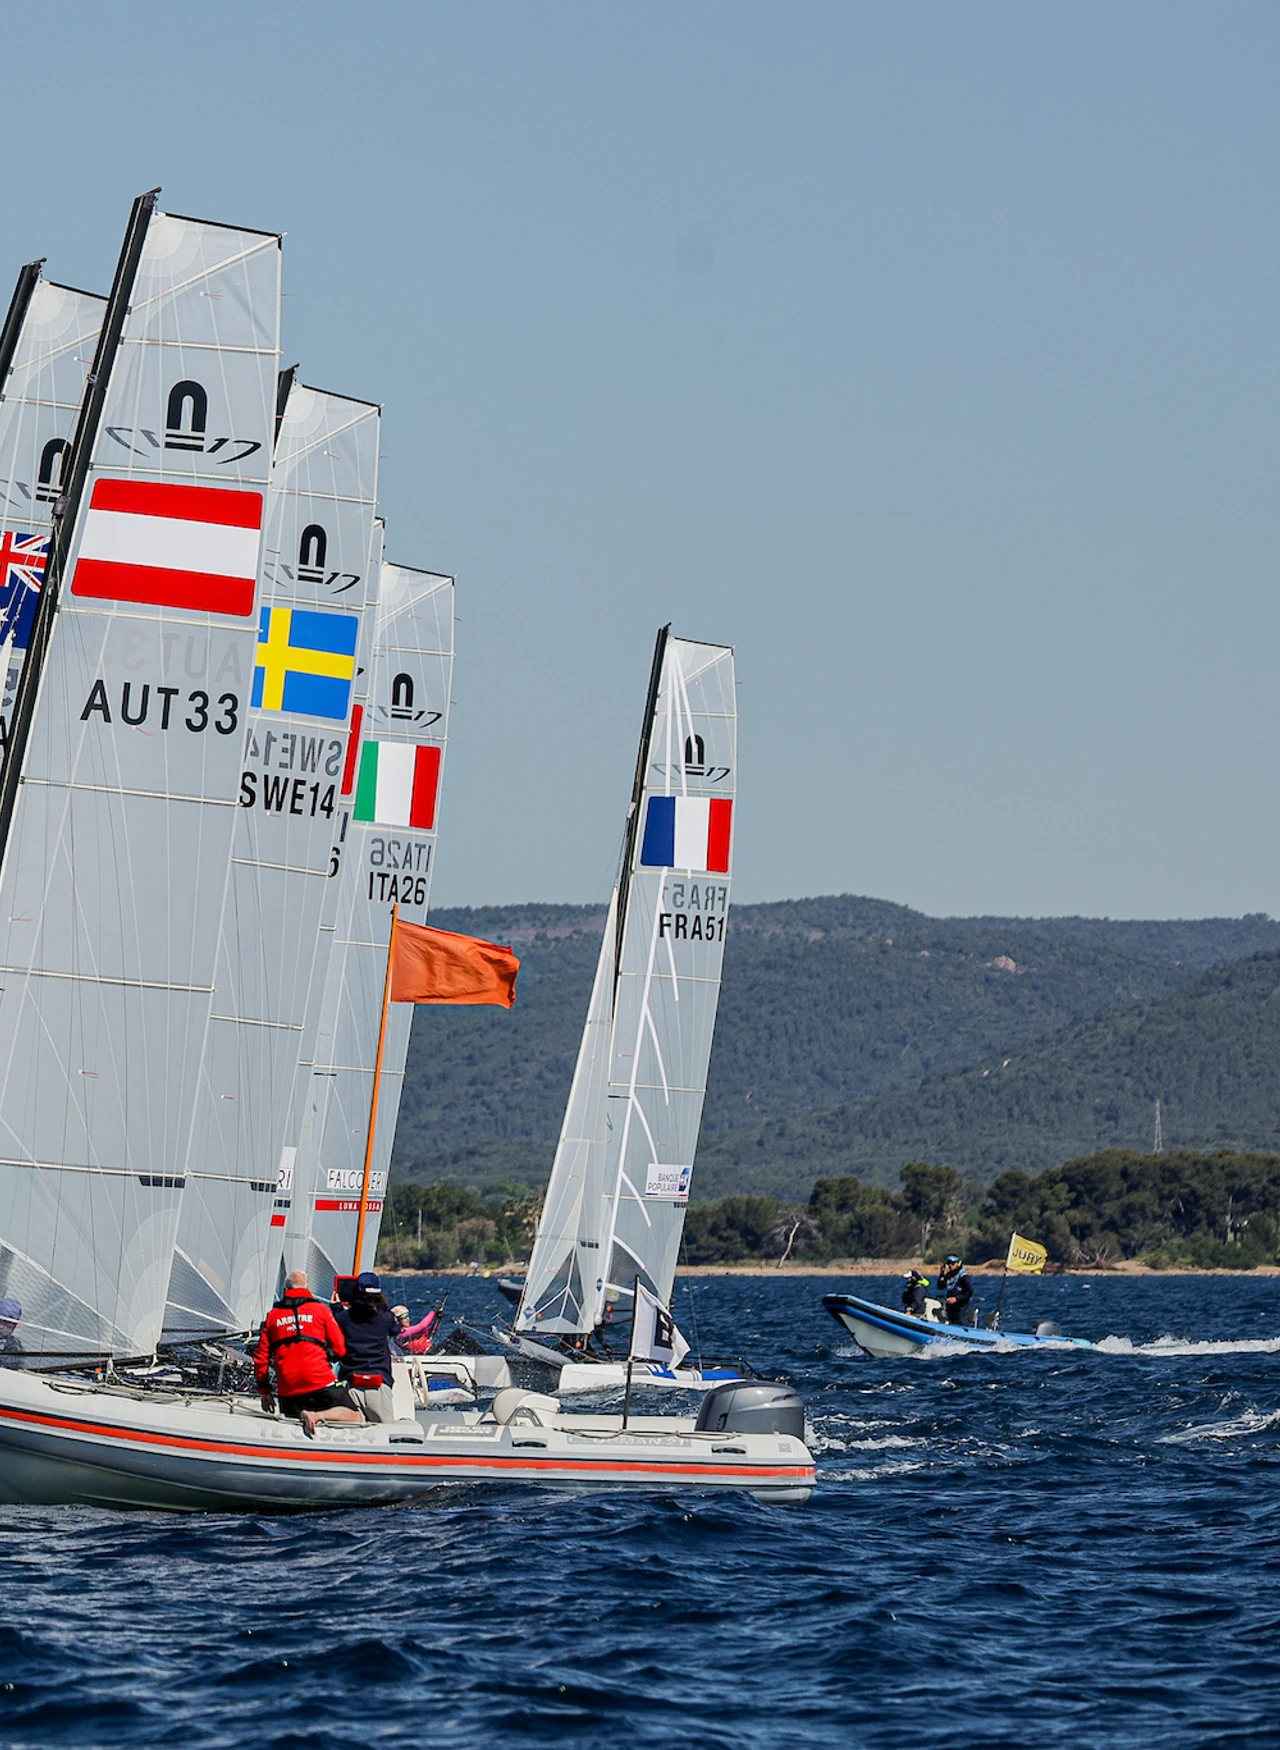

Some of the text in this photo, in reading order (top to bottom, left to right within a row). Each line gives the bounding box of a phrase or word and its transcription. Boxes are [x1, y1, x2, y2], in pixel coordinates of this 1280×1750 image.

[80, 679, 239, 735] AUT33
[239, 771, 336, 819] SWE14
[368, 871, 427, 905] ITA26
[659, 913, 725, 942] FRA51
[658, 1173, 679, 1182] BANQUE
[1013, 1248, 1041, 1264] JURY
